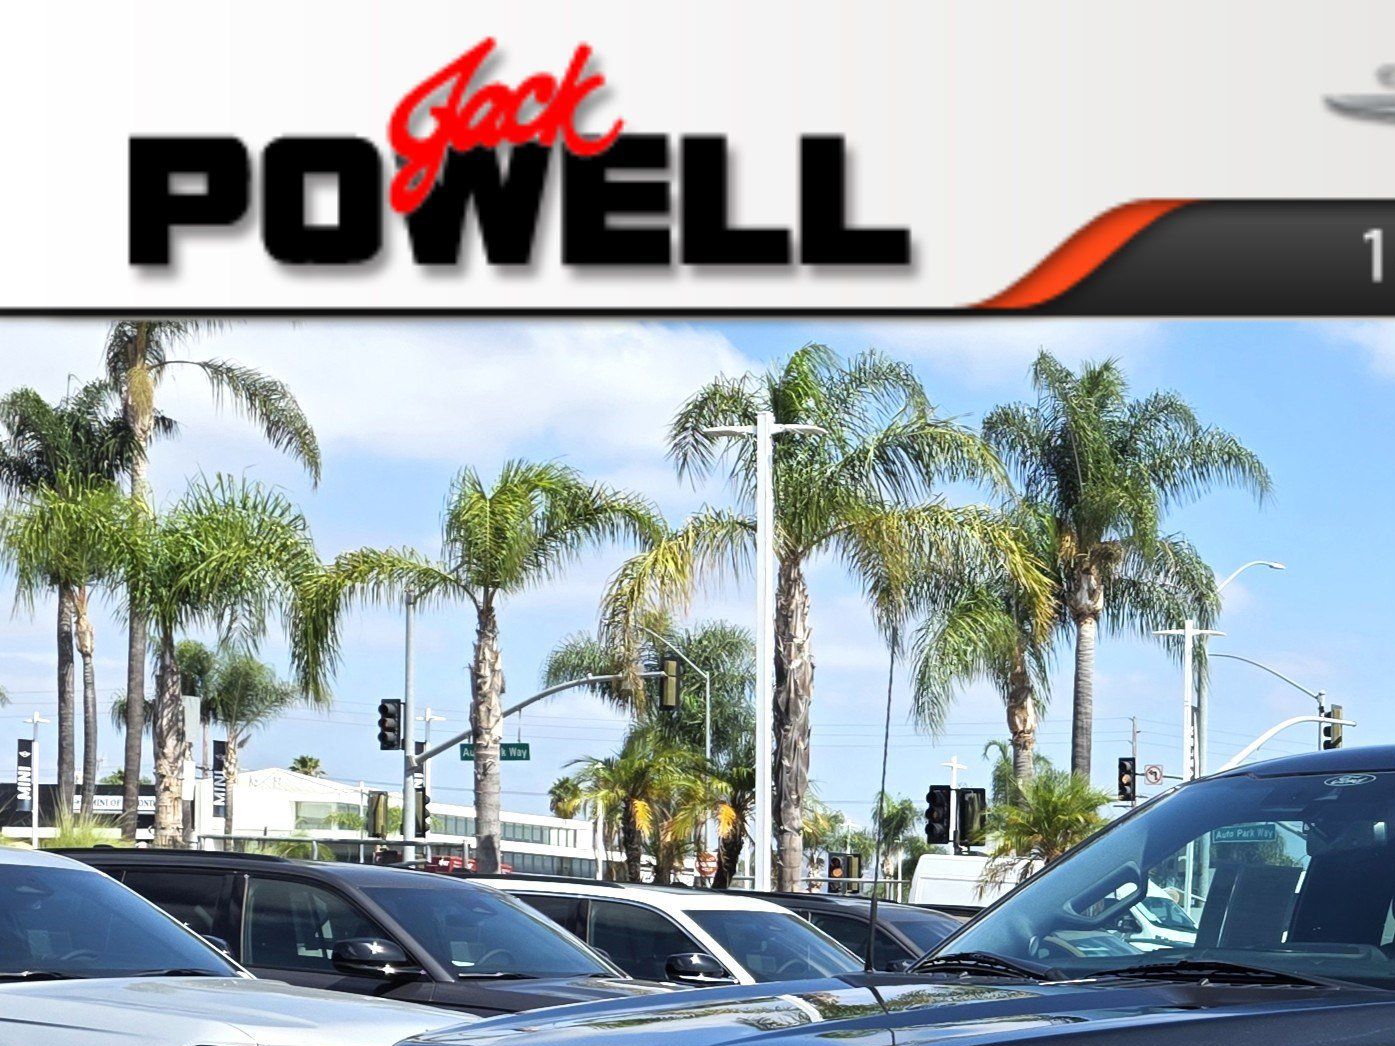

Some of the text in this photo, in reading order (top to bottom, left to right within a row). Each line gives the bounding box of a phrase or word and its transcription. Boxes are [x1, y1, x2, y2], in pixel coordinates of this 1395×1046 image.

[509, 747, 528, 758] Way
[17, 766, 32, 800] MINI
[214, 770, 227, 806] MINI
[1215, 828, 1274, 840] Auto Park Way
